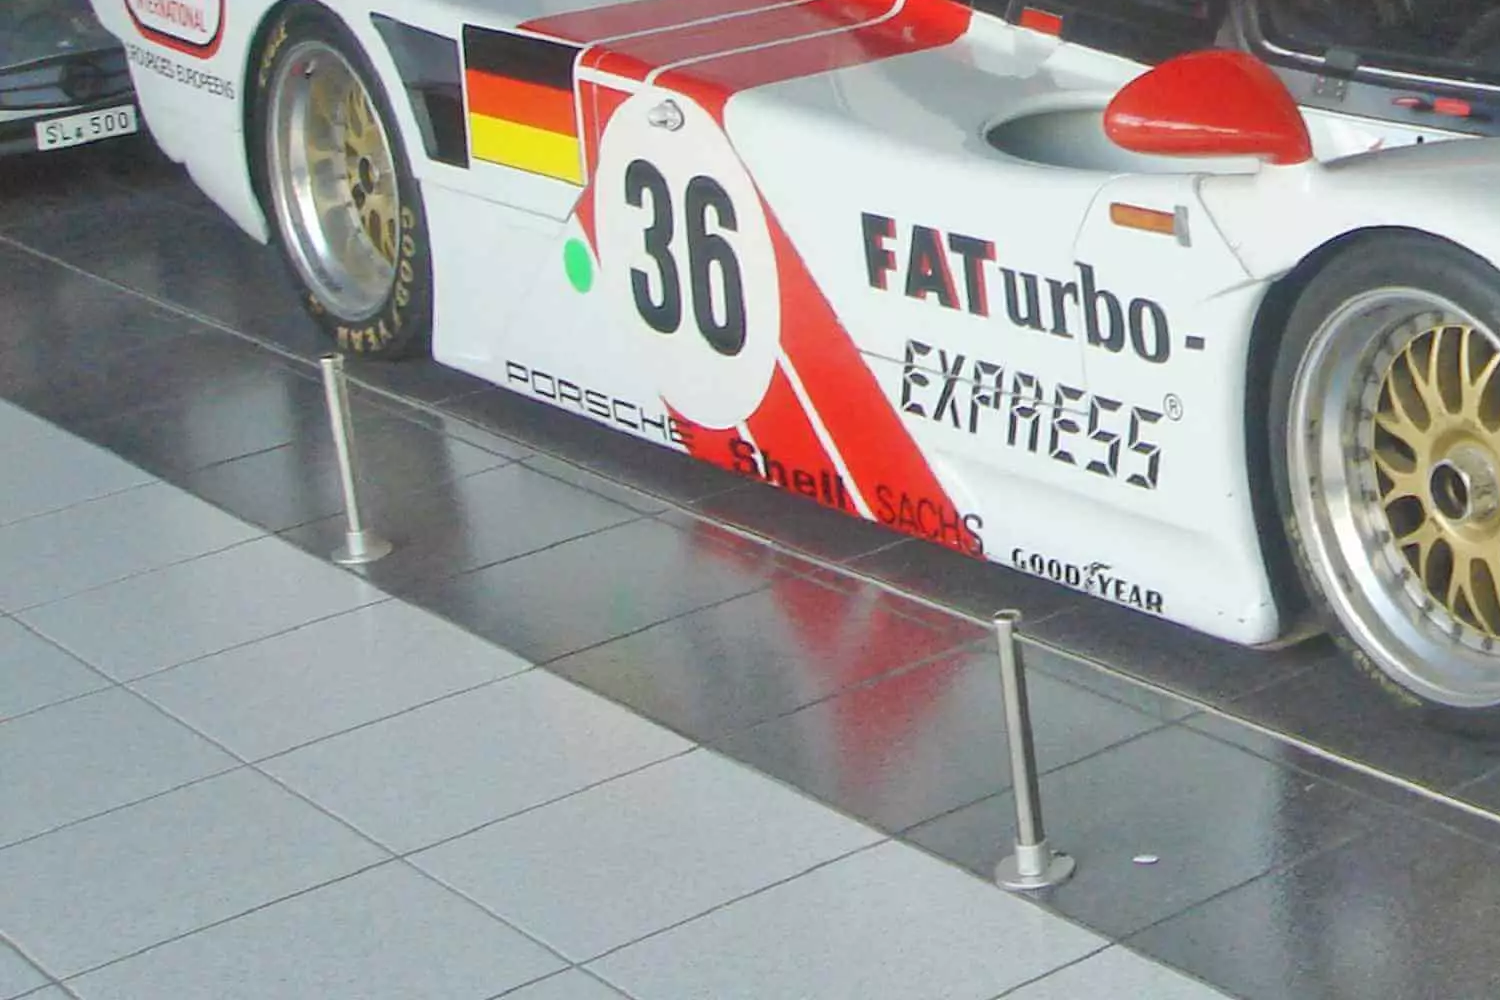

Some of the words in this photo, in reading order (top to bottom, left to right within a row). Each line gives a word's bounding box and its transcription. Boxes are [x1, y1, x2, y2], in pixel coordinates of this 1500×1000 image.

[90, 111, 128, 135] 500
[624, 158, 747, 357] 36
[506, 360, 694, 450] PORSCHE
[729, 438, 857, 507] Shell
[875, 485, 985, 556] SACHS
